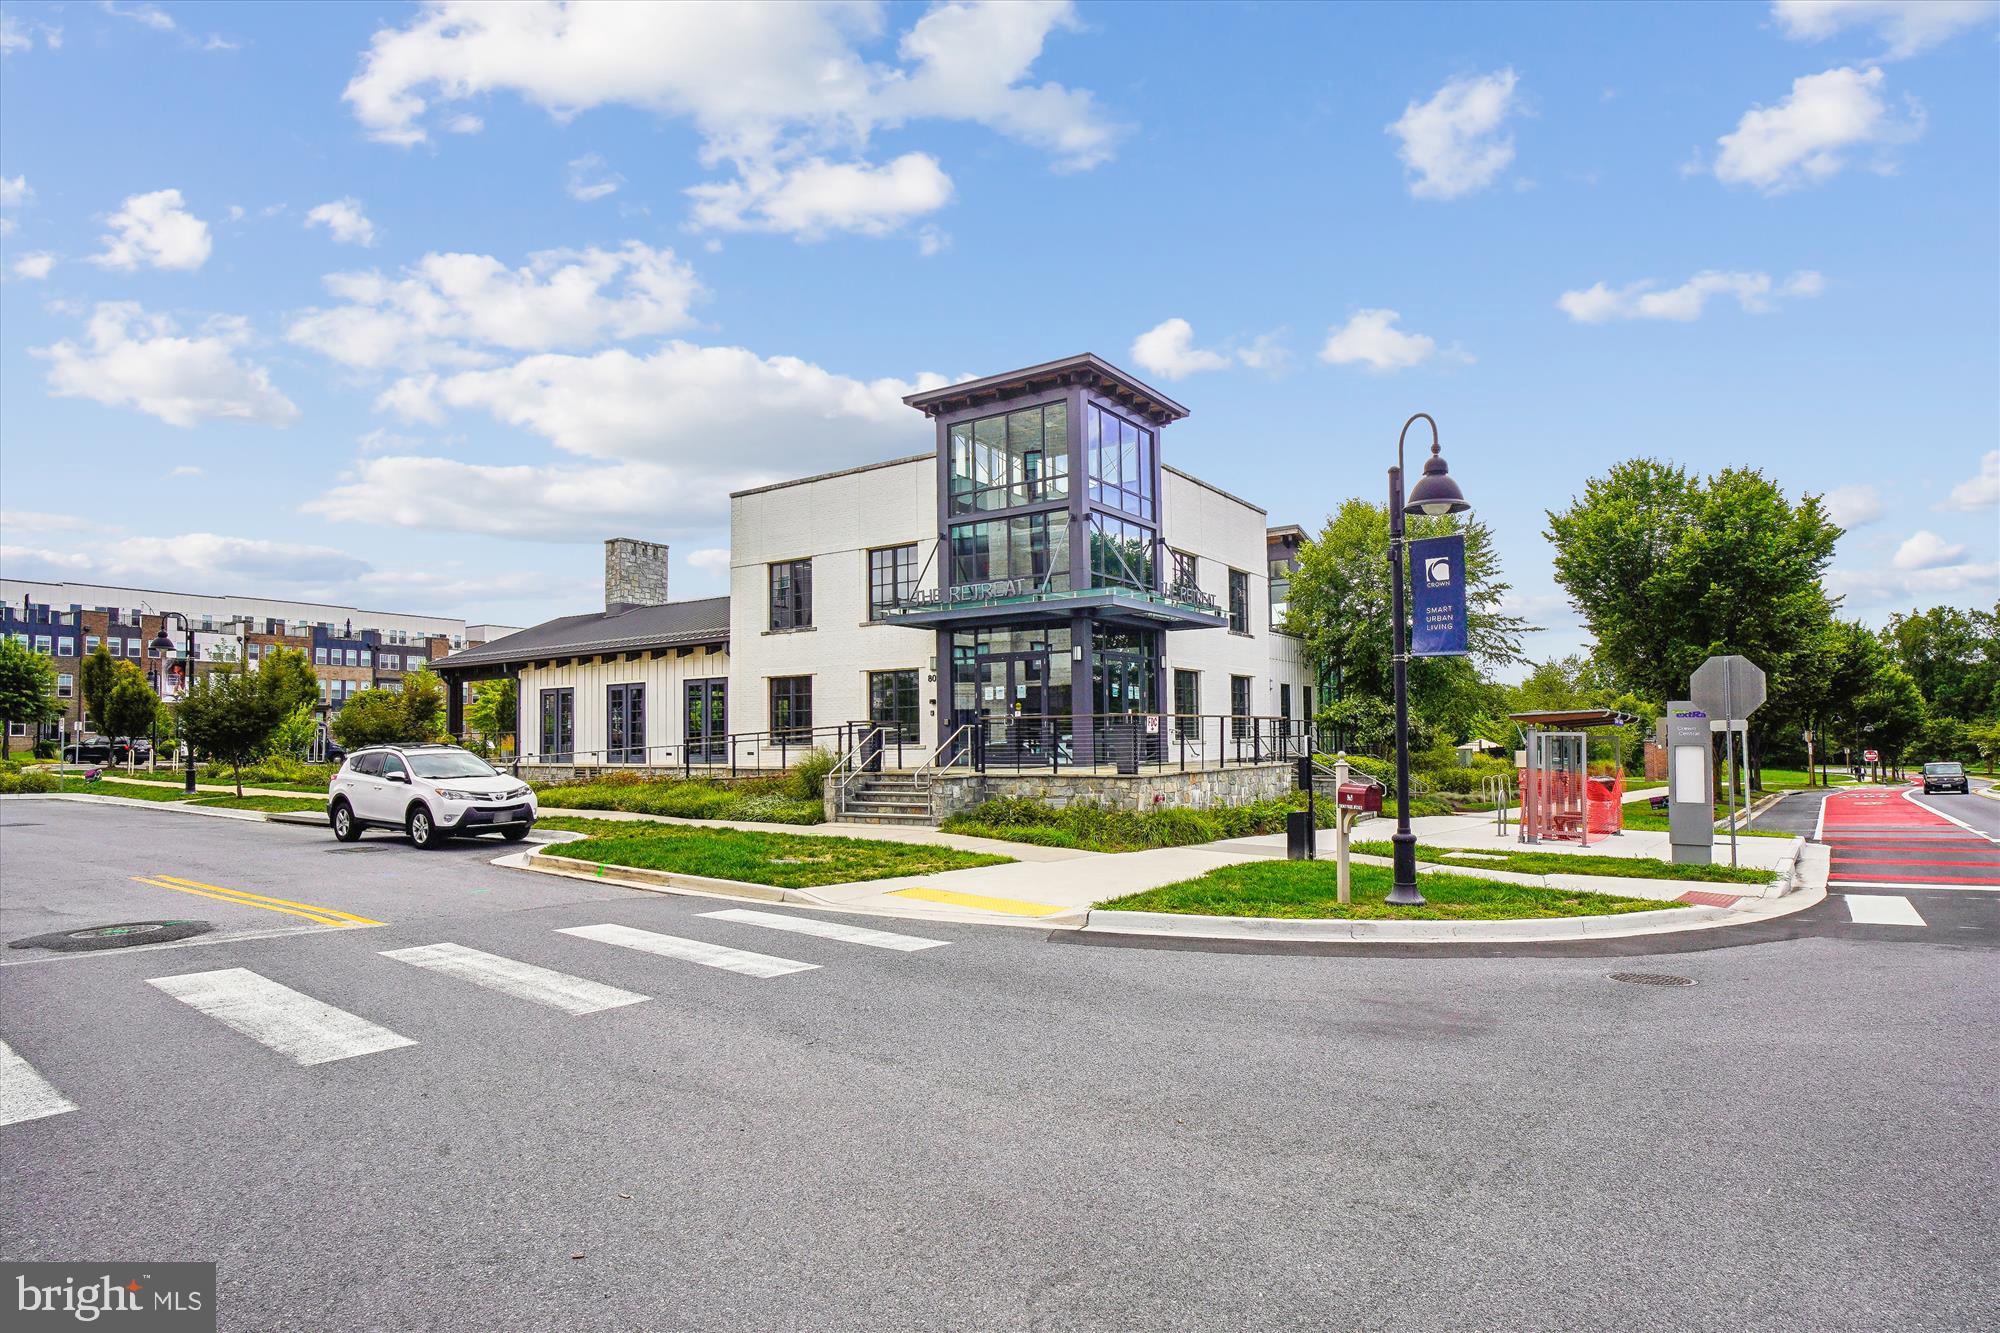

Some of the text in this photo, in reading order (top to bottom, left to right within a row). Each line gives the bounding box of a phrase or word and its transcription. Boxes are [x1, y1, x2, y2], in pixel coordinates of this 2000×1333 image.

[913, 578, 1025, 605] THE RETREAT
[1426, 605, 1452, 614] SMART
[1426, 622, 1453, 631] LIVING
